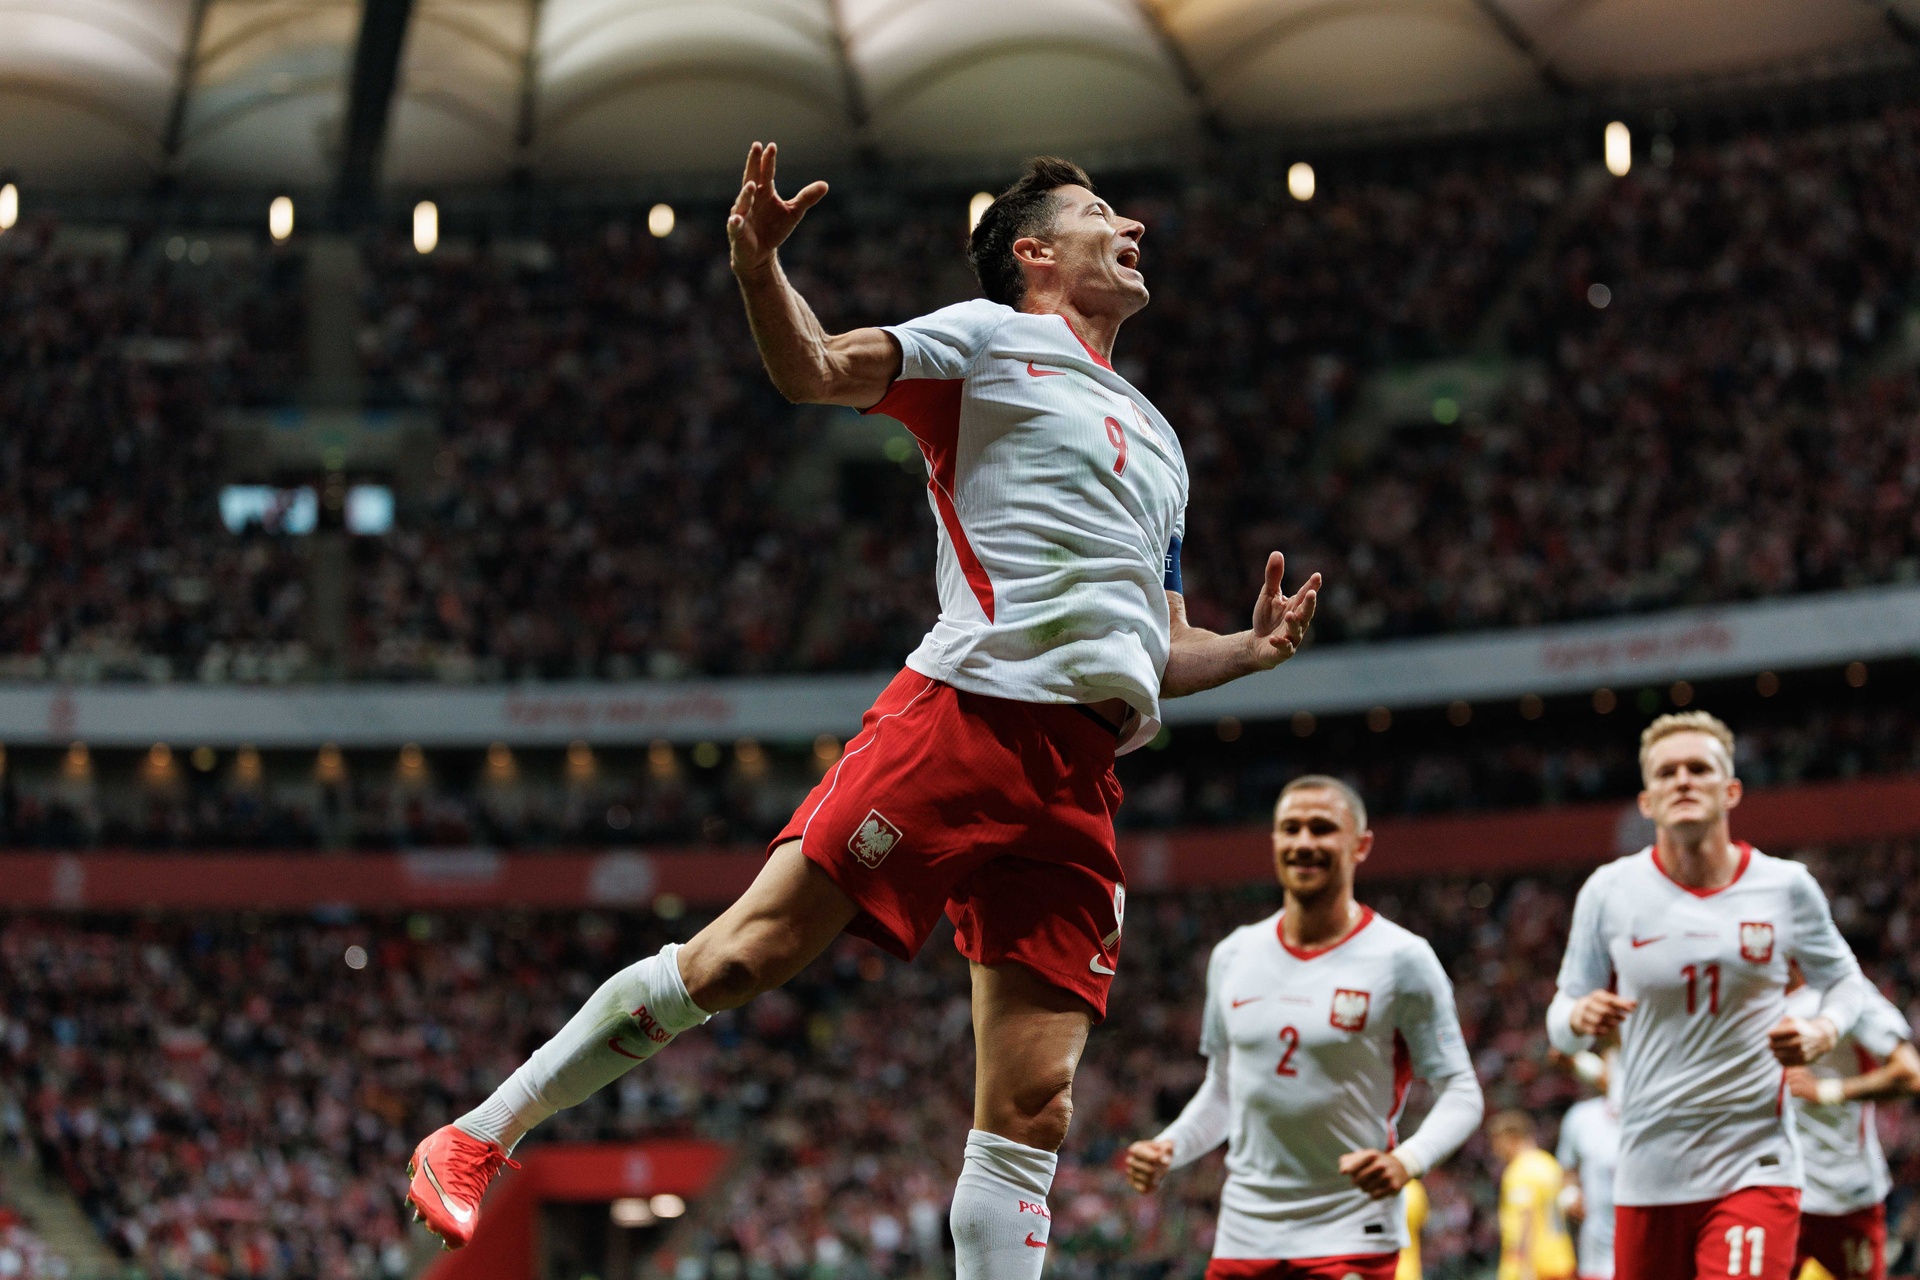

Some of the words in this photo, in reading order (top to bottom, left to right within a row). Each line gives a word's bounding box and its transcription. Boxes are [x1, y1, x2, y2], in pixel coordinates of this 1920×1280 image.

[1105, 417, 1128, 477] 9
[1681, 964, 1720, 1015] 11
[1276, 1026, 1300, 1076] 2
[1725, 1225, 1765, 1277] 11
